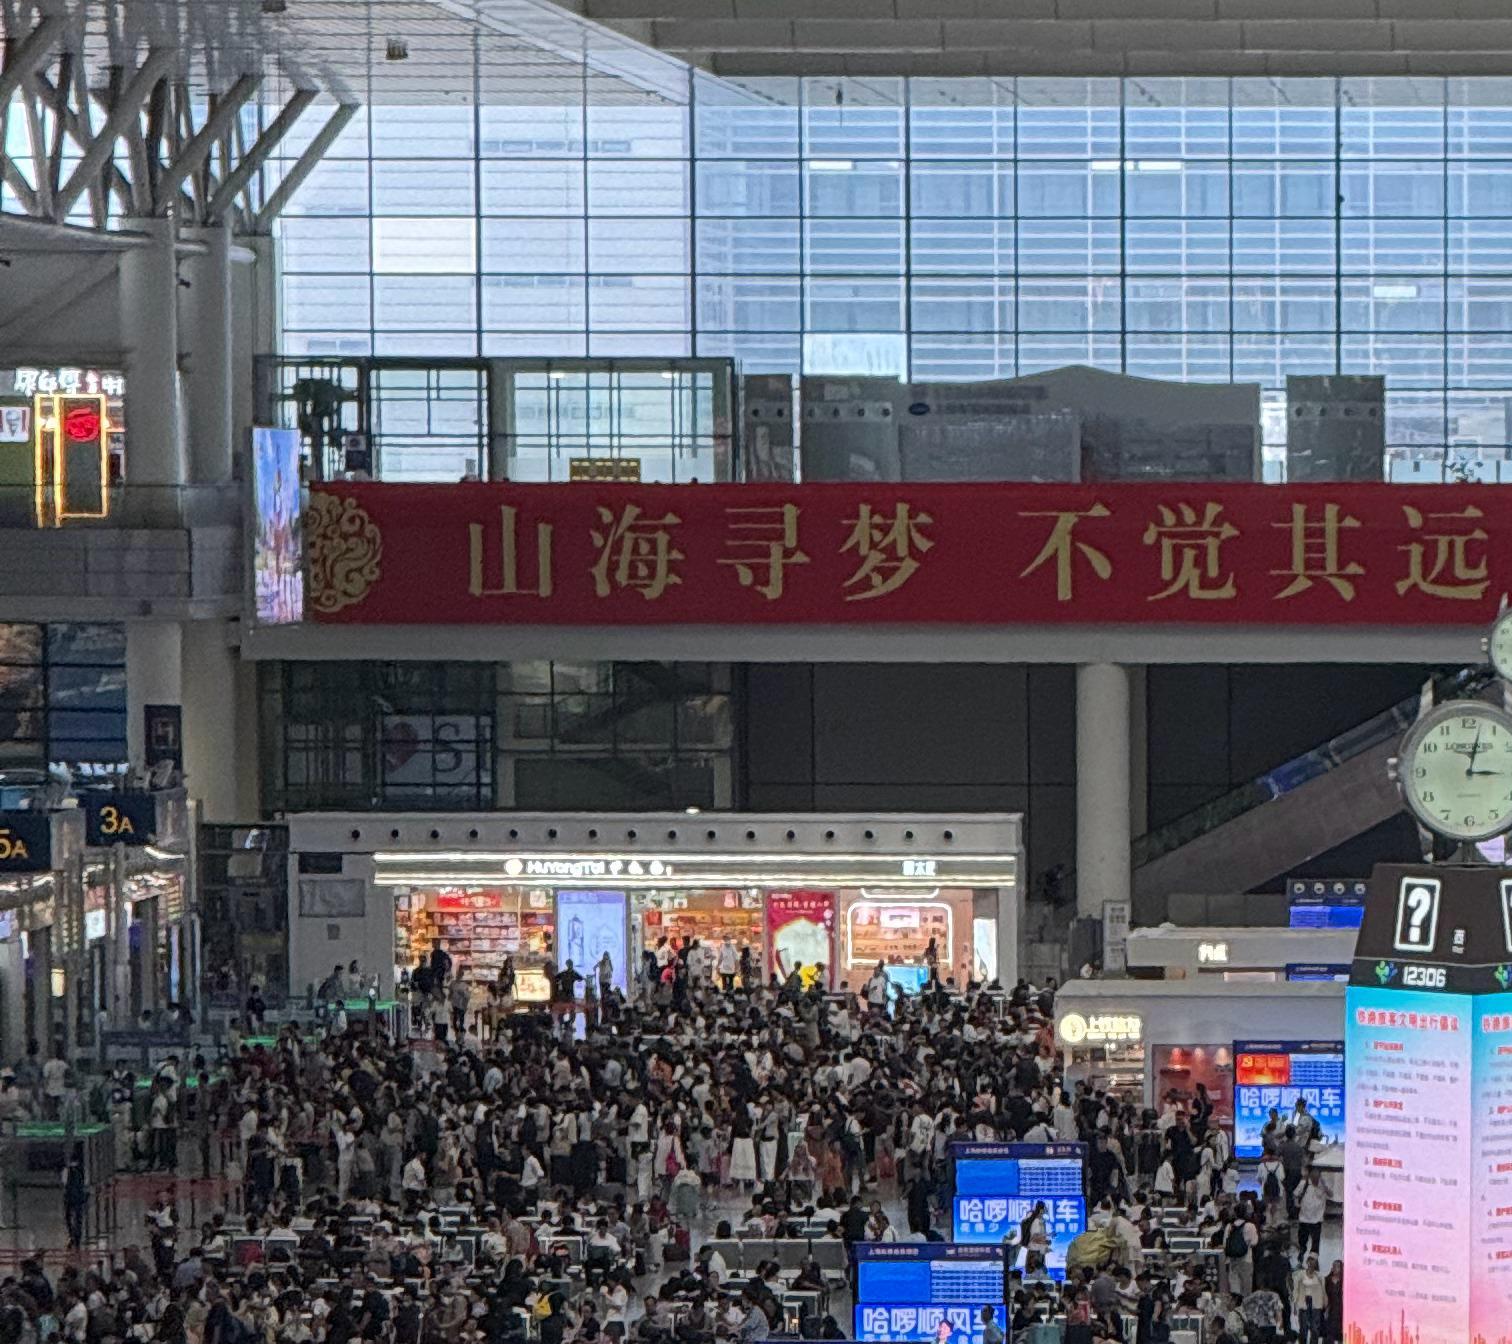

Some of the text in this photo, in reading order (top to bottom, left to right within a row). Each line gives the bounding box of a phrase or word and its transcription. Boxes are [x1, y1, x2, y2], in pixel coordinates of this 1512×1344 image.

[468, 502, 932, 600] 山海寻梦
[1018, 502, 1489, 600] 不觉其远
[99, 806, 134, 834] 3A
[0, 829, 28, 860] 5A
[1402, 965, 1447, 987] 12306
